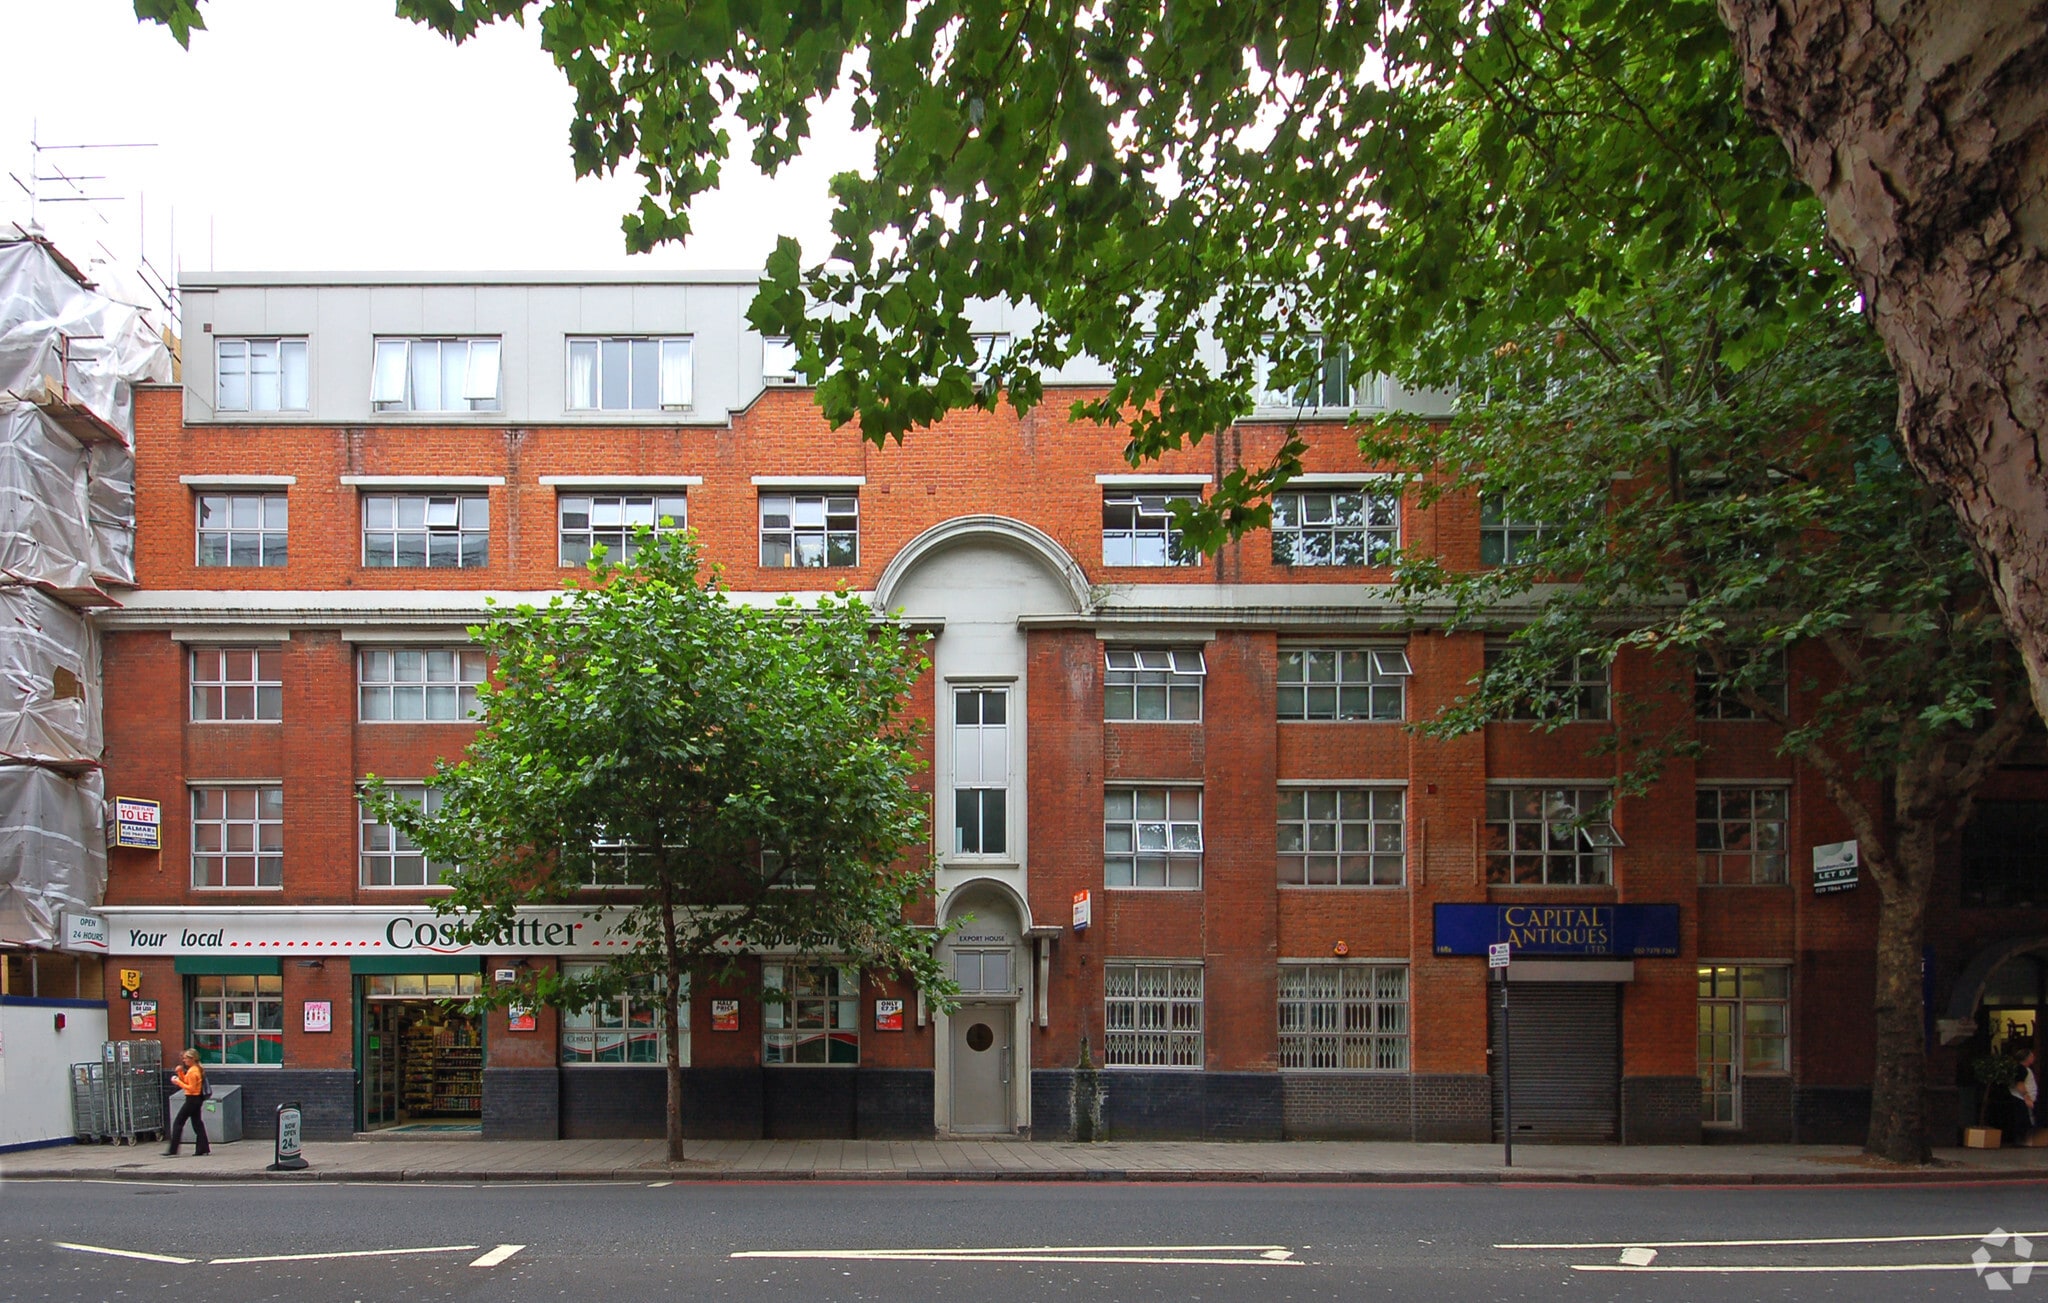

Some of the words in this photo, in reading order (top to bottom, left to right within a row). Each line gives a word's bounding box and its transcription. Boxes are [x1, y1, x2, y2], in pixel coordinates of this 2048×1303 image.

[121, 810, 134, 819] TO
[137, 812, 154, 821] LET
[1818, 871, 1836, 879] LET
[1839, 868, 1852, 876] BY
[80, 918, 96, 927] OPEN
[1505, 907, 1603, 927] CAPITAL
[73, 930, 82, 938] 24
[83, 931, 104, 941] HOURS
[130, 929, 168, 947] Your
[181, 928, 224, 947] local
[386, 917, 577, 949] Costutter
[1508, 928, 1608, 948] ANTIQUES
